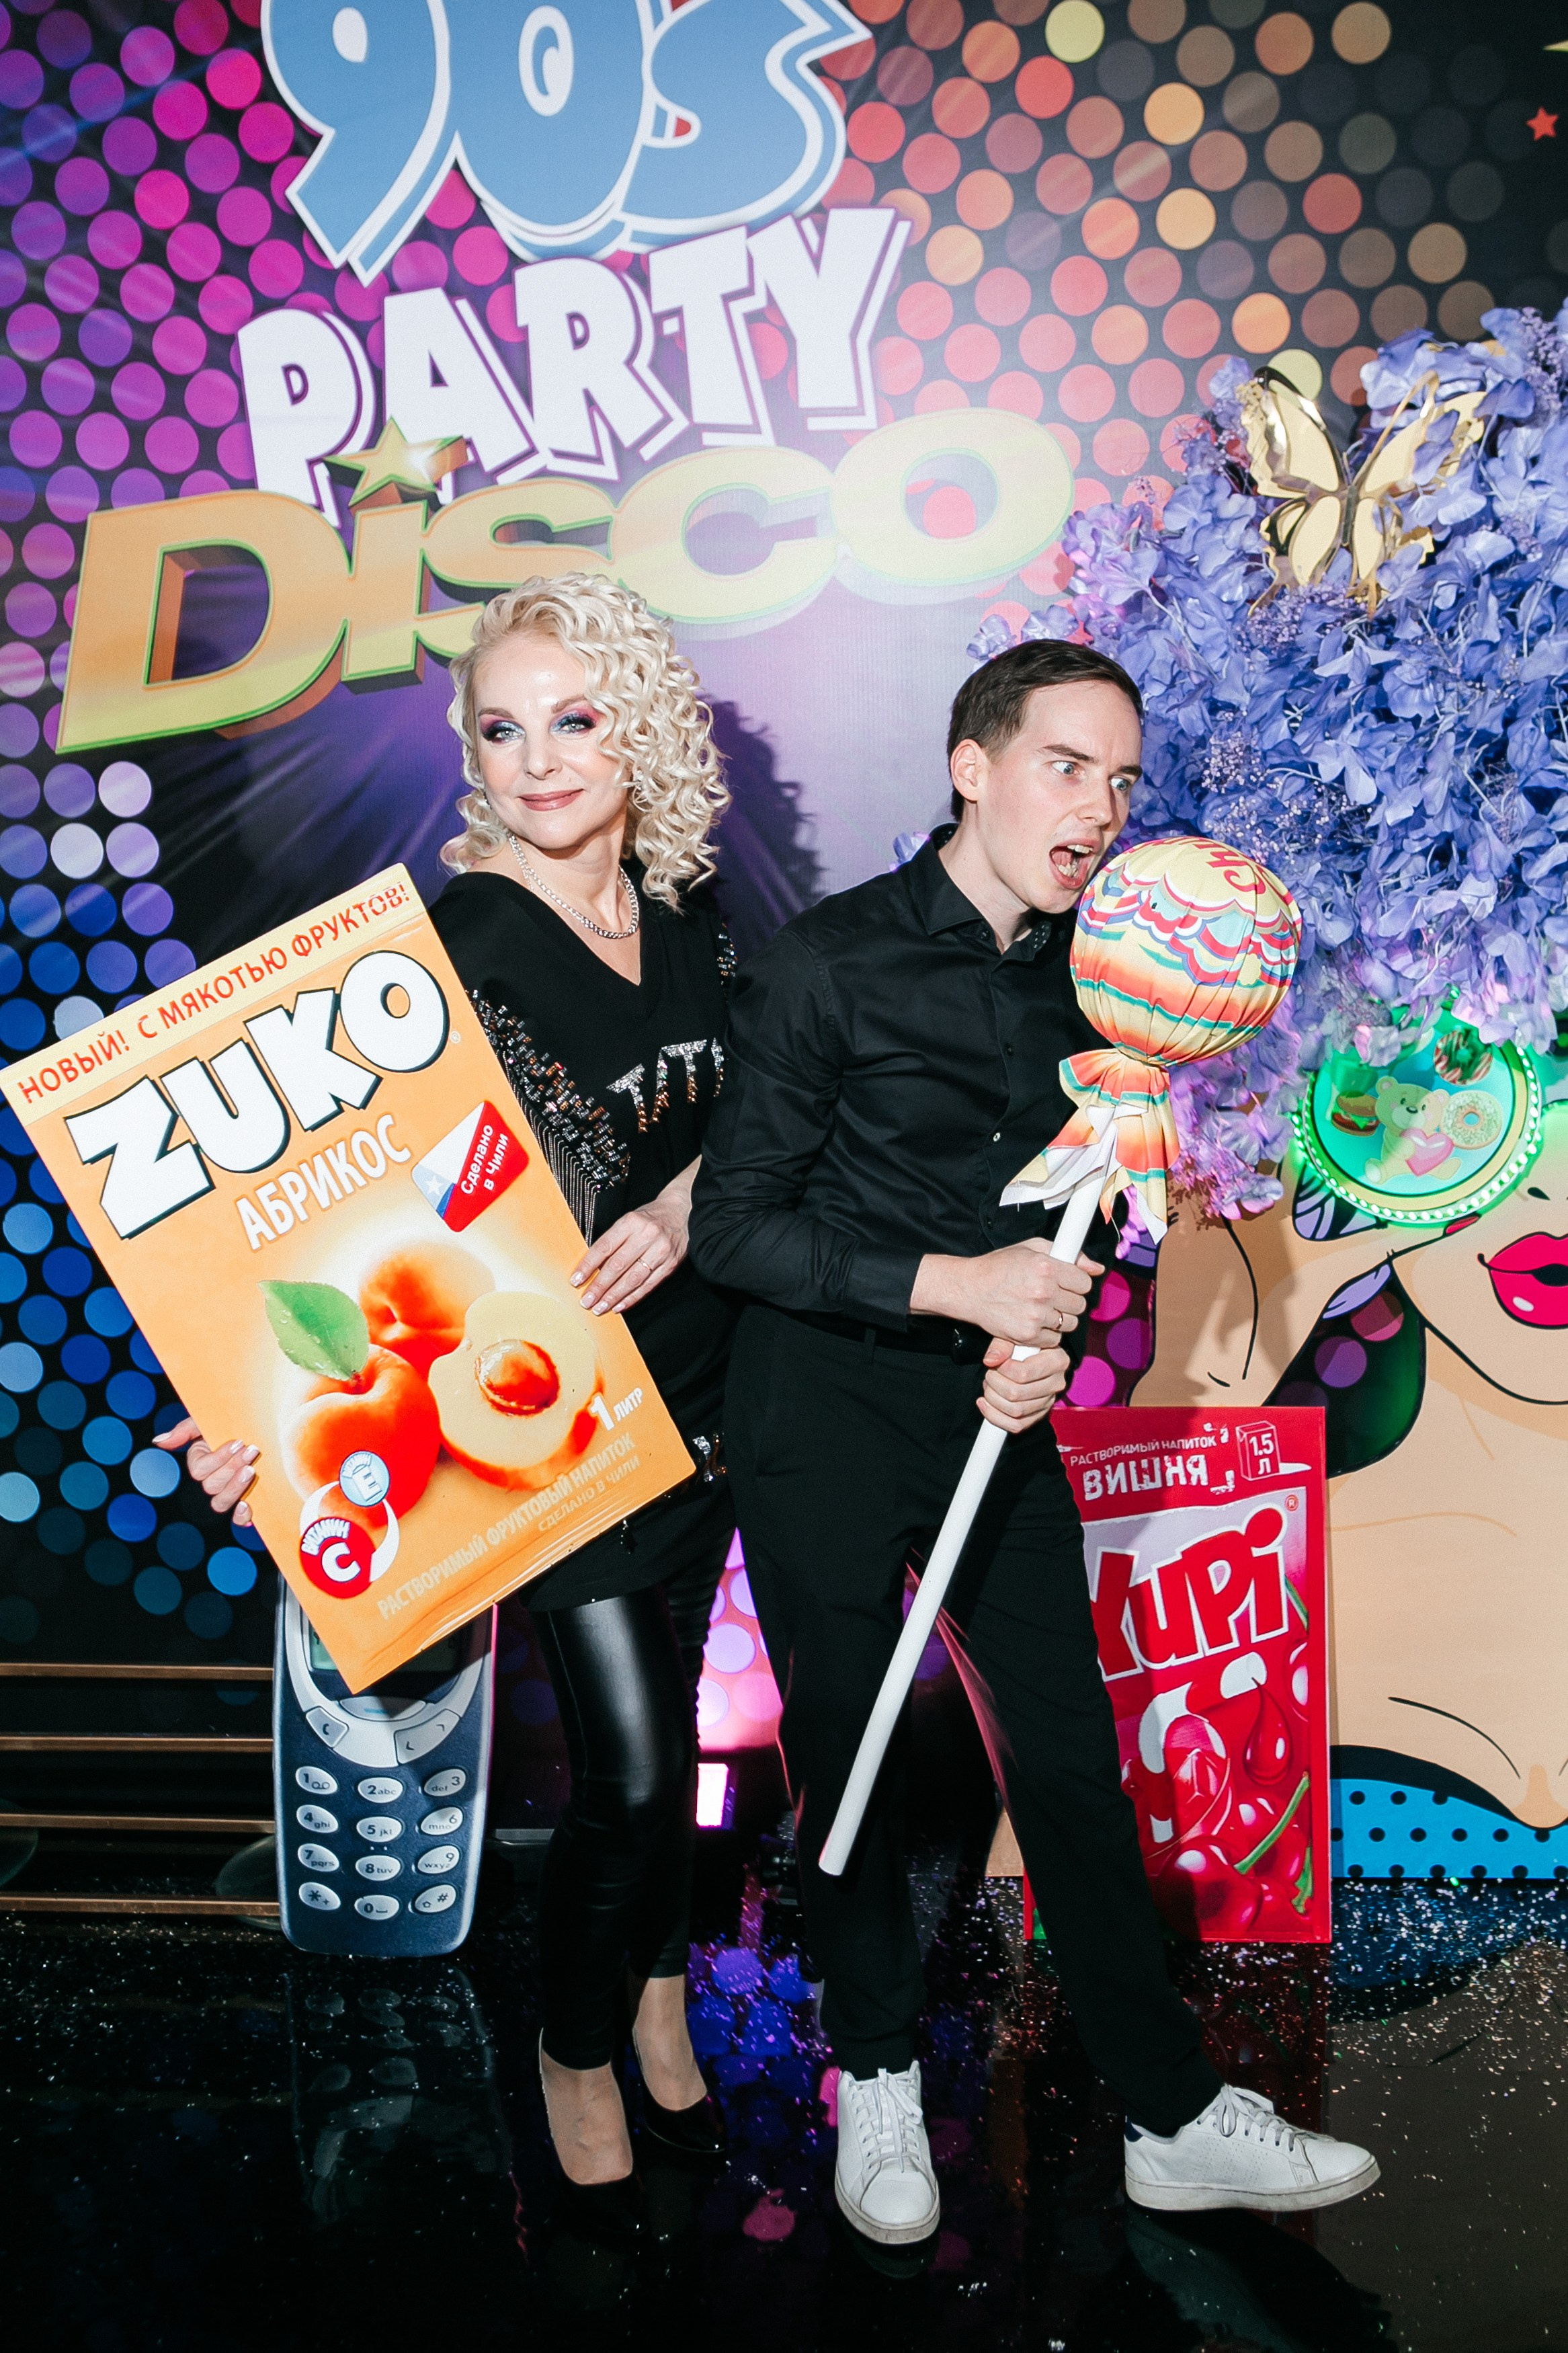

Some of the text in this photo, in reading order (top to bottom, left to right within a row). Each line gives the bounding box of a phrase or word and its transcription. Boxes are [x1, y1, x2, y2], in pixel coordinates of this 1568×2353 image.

[237, 207, 912, 528] PARTY
[18, 881, 411, 1104] НОВЫЙ! С МЯКОТЬЮ ФРУКТОВ!
[63, 949, 450, 1241] ZUKO
[235, 1113, 413, 1251] АБРИКОС
[460, 1125, 494, 1195] Сделано
[483, 1133, 509, 1191] в Чили
[589, 1387, 644, 1431] 1 ЛИТР
[1069, 1435, 1217, 1467] РАСТВОРИМЫЙ НАПИТОК
[1249, 1433, 1274, 1456] 1.5
[538, 1455, 641, 1532] СДЕЛАНО В ЧИЛИ
[1083, 1454, 1208, 1501] ВИШНЯ
[376, 1432, 636, 1620] РАСТВОРИМЫЙ ФРУКТОВЫЙ НАПИТОК
[451, 1776, 460, 1786] 3
[303, 1812, 314, 1823] 4
[367, 1825, 376, 1835] 5
[449, 1814, 458, 1825] 6
[304, 1849, 314, 1860] 7
[365, 1864, 375, 1874] 8
[446, 1852, 455, 1862] 9
